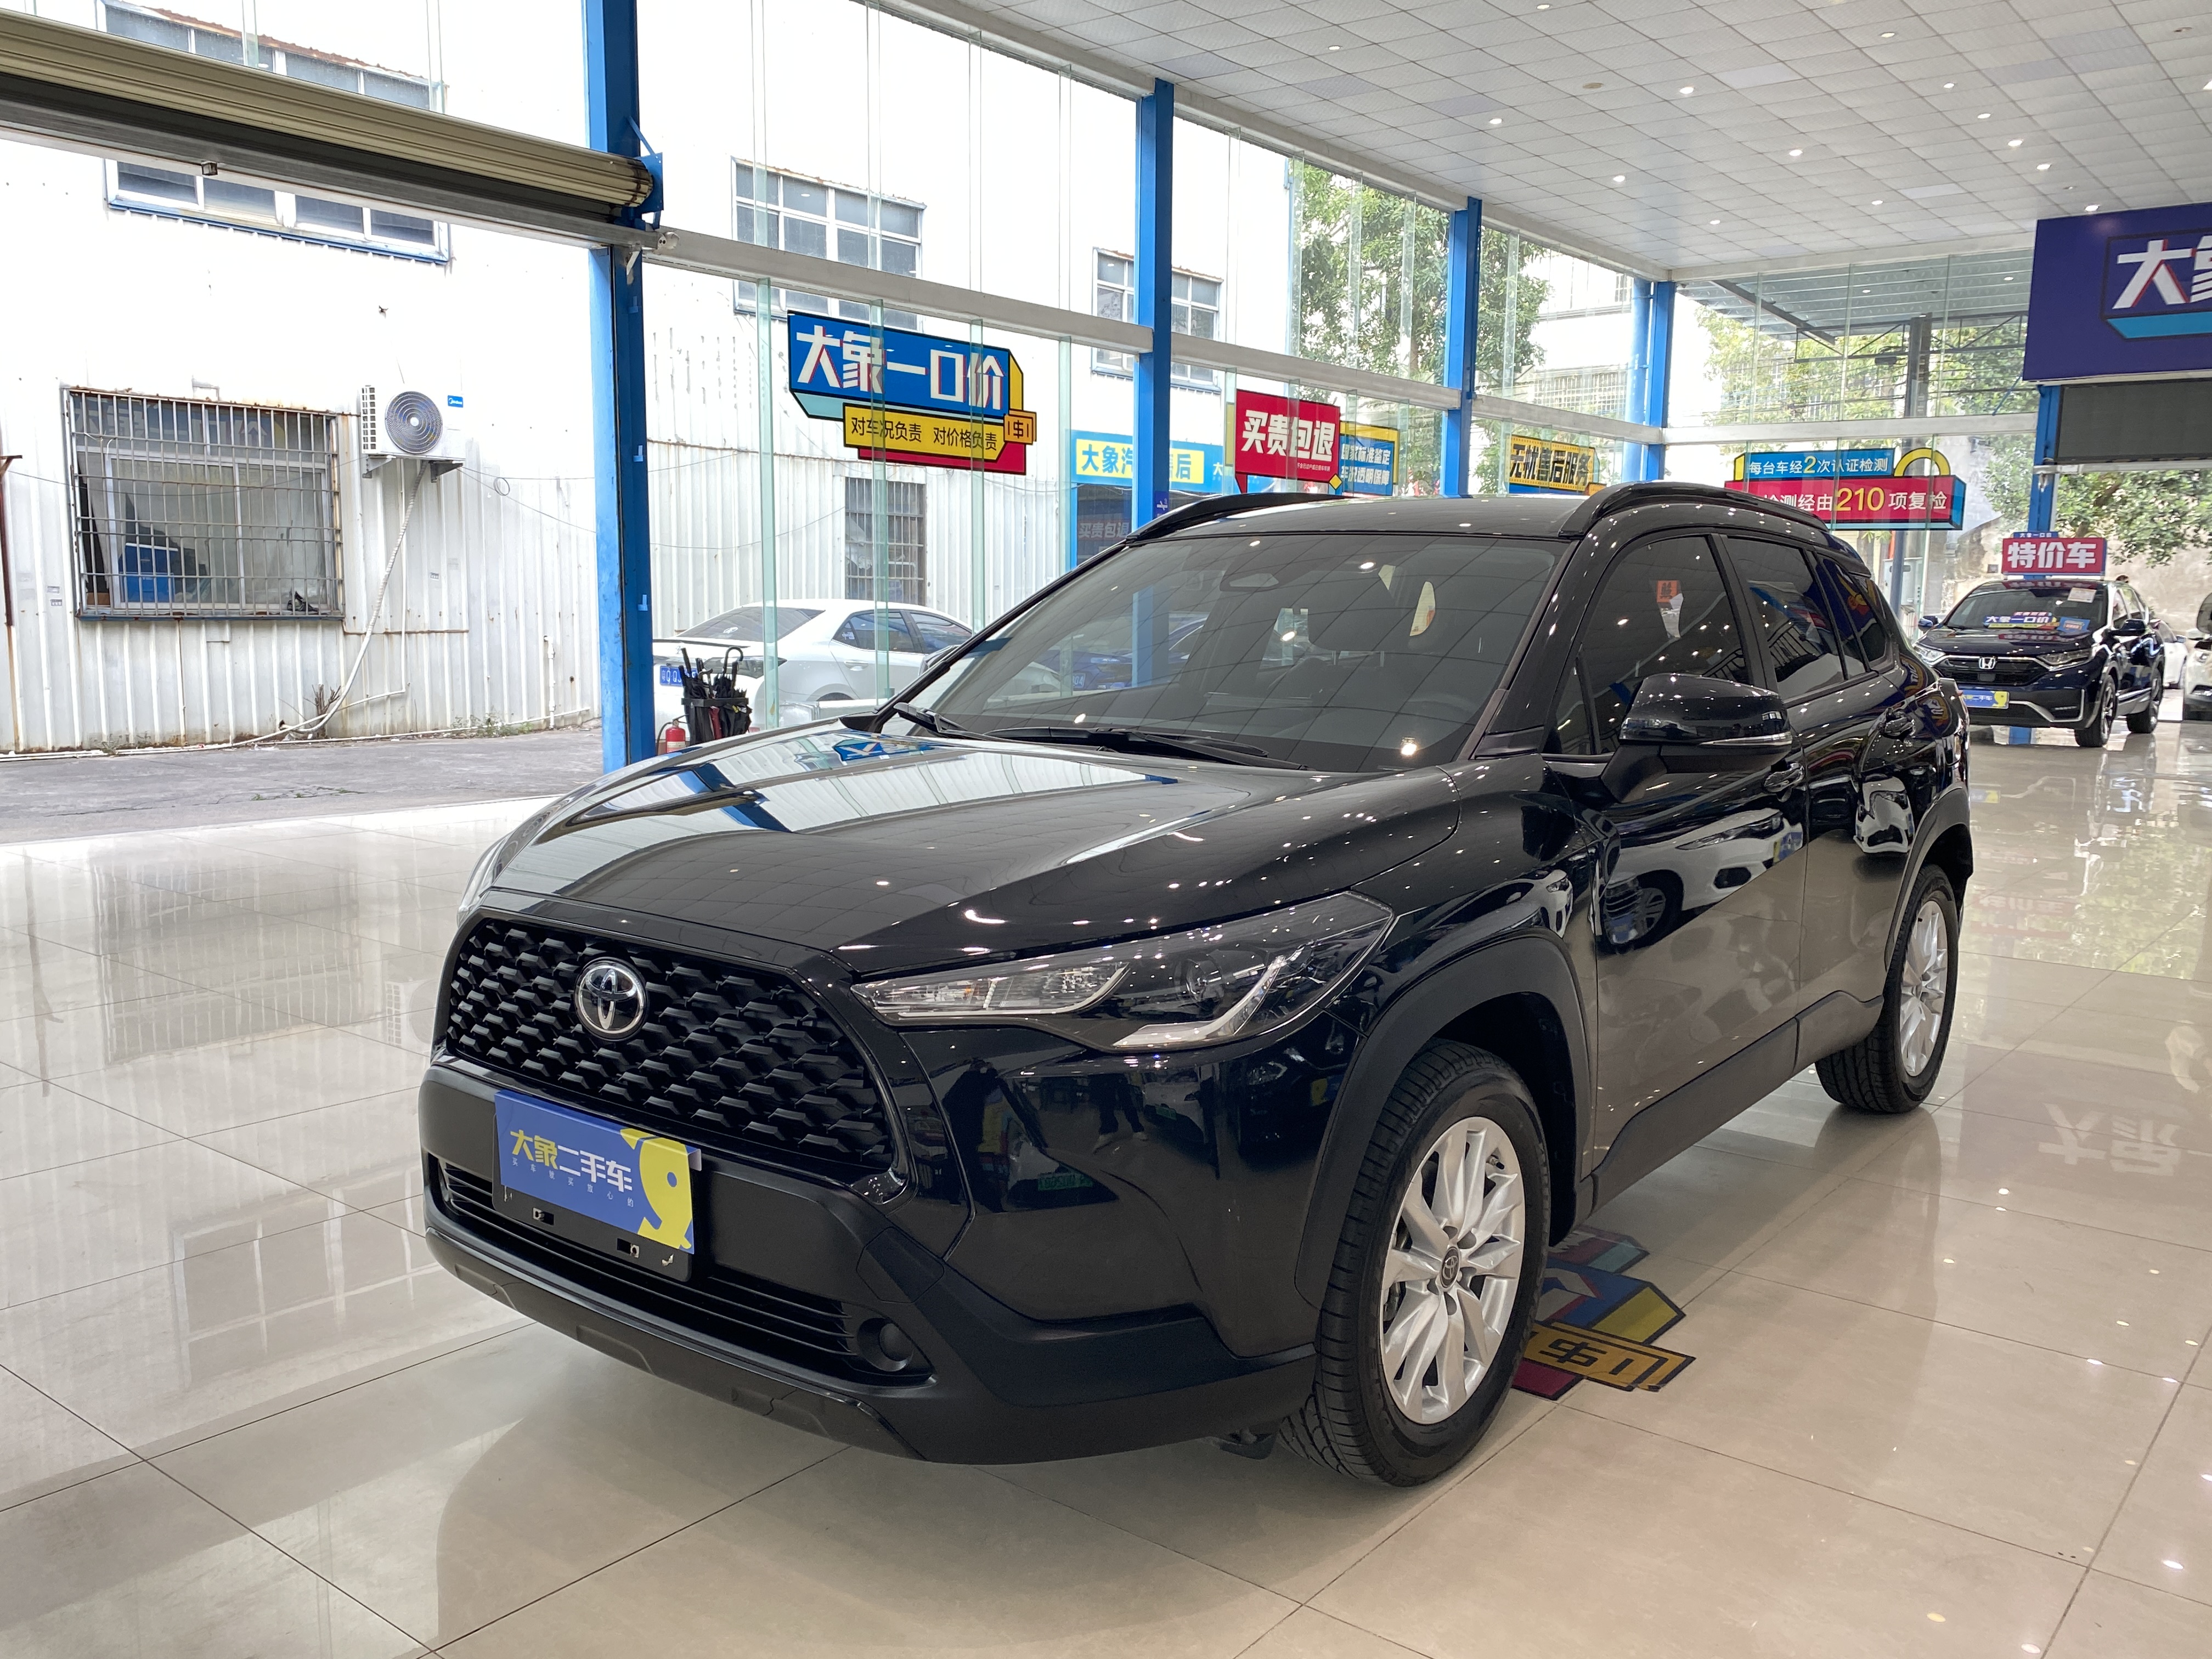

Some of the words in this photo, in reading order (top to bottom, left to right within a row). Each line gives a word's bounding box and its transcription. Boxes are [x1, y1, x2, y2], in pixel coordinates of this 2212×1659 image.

[2112, 235, 2212, 309] 大
[796, 325, 1005, 410] 大象一口价
[851, 416, 922, 443] 对车况负责
[933, 426, 997, 452] 对价格负责
[1241, 409, 1335, 462] 买贵包退
[1341, 443, 1391, 465] 国家标准鉴定
[1510, 443, 1591, 486] 无忧售后服务
[1748, 456, 1888, 475] 每台车经2次认证检测
[1340, 466, 1390, 486] 车况透明保障
[1079, 522, 1129, 539] 买贵包退
[2007, 542, 2097, 568] 特价车
[510, 1129, 633, 1193] 大象二手车
